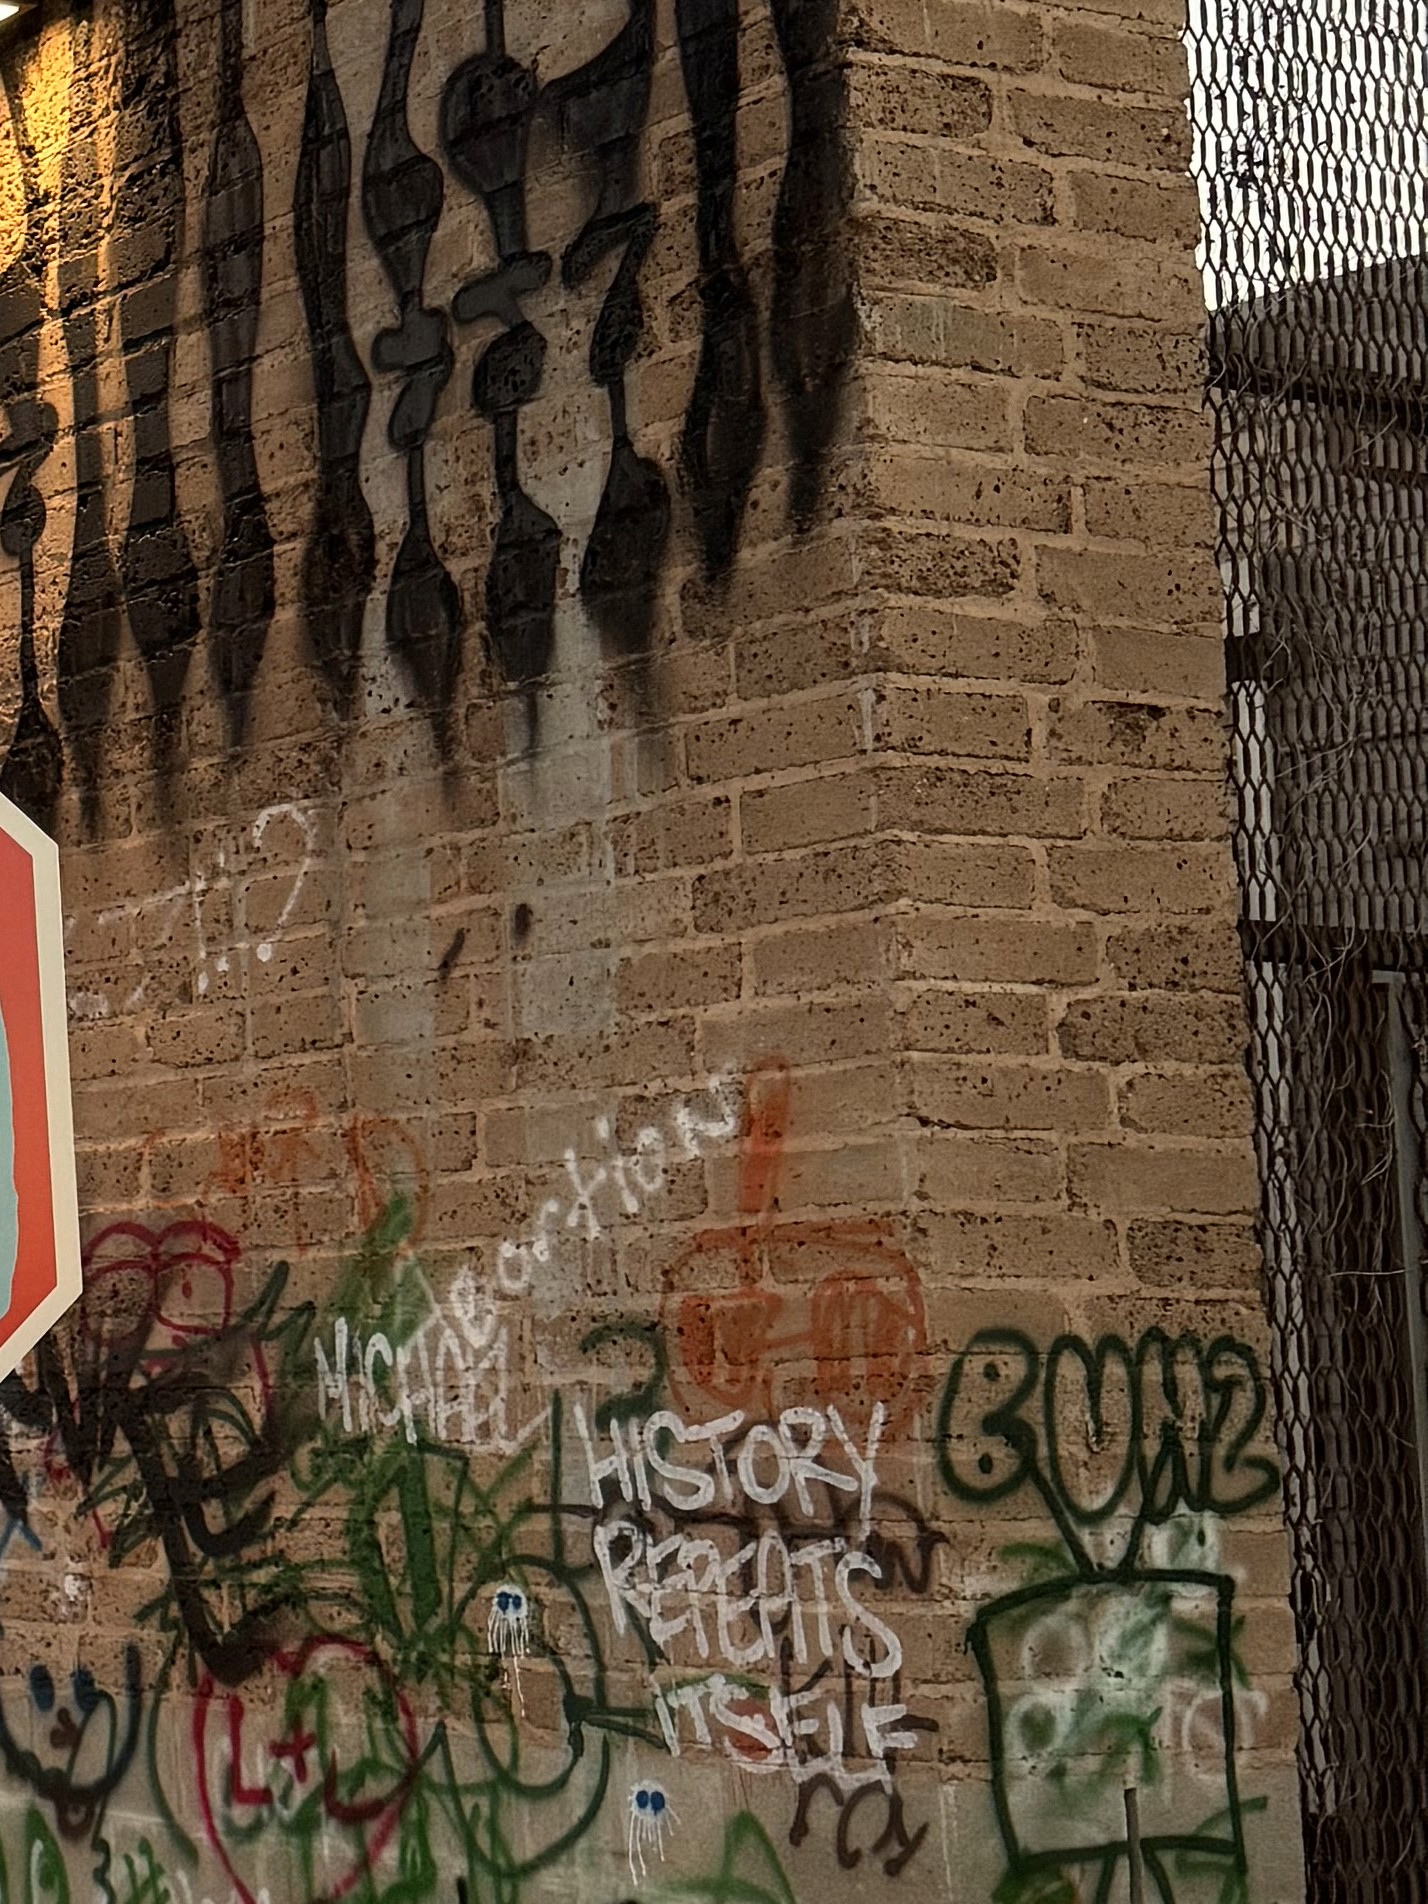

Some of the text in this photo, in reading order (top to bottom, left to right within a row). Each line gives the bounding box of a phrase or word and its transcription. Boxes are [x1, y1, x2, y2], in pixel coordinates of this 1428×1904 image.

[574, 1401, 886, 1541] HISTORY
[593, 1520, 903, 1678] REPEATS
[648, 1674, 919, 1794] ITSELF
